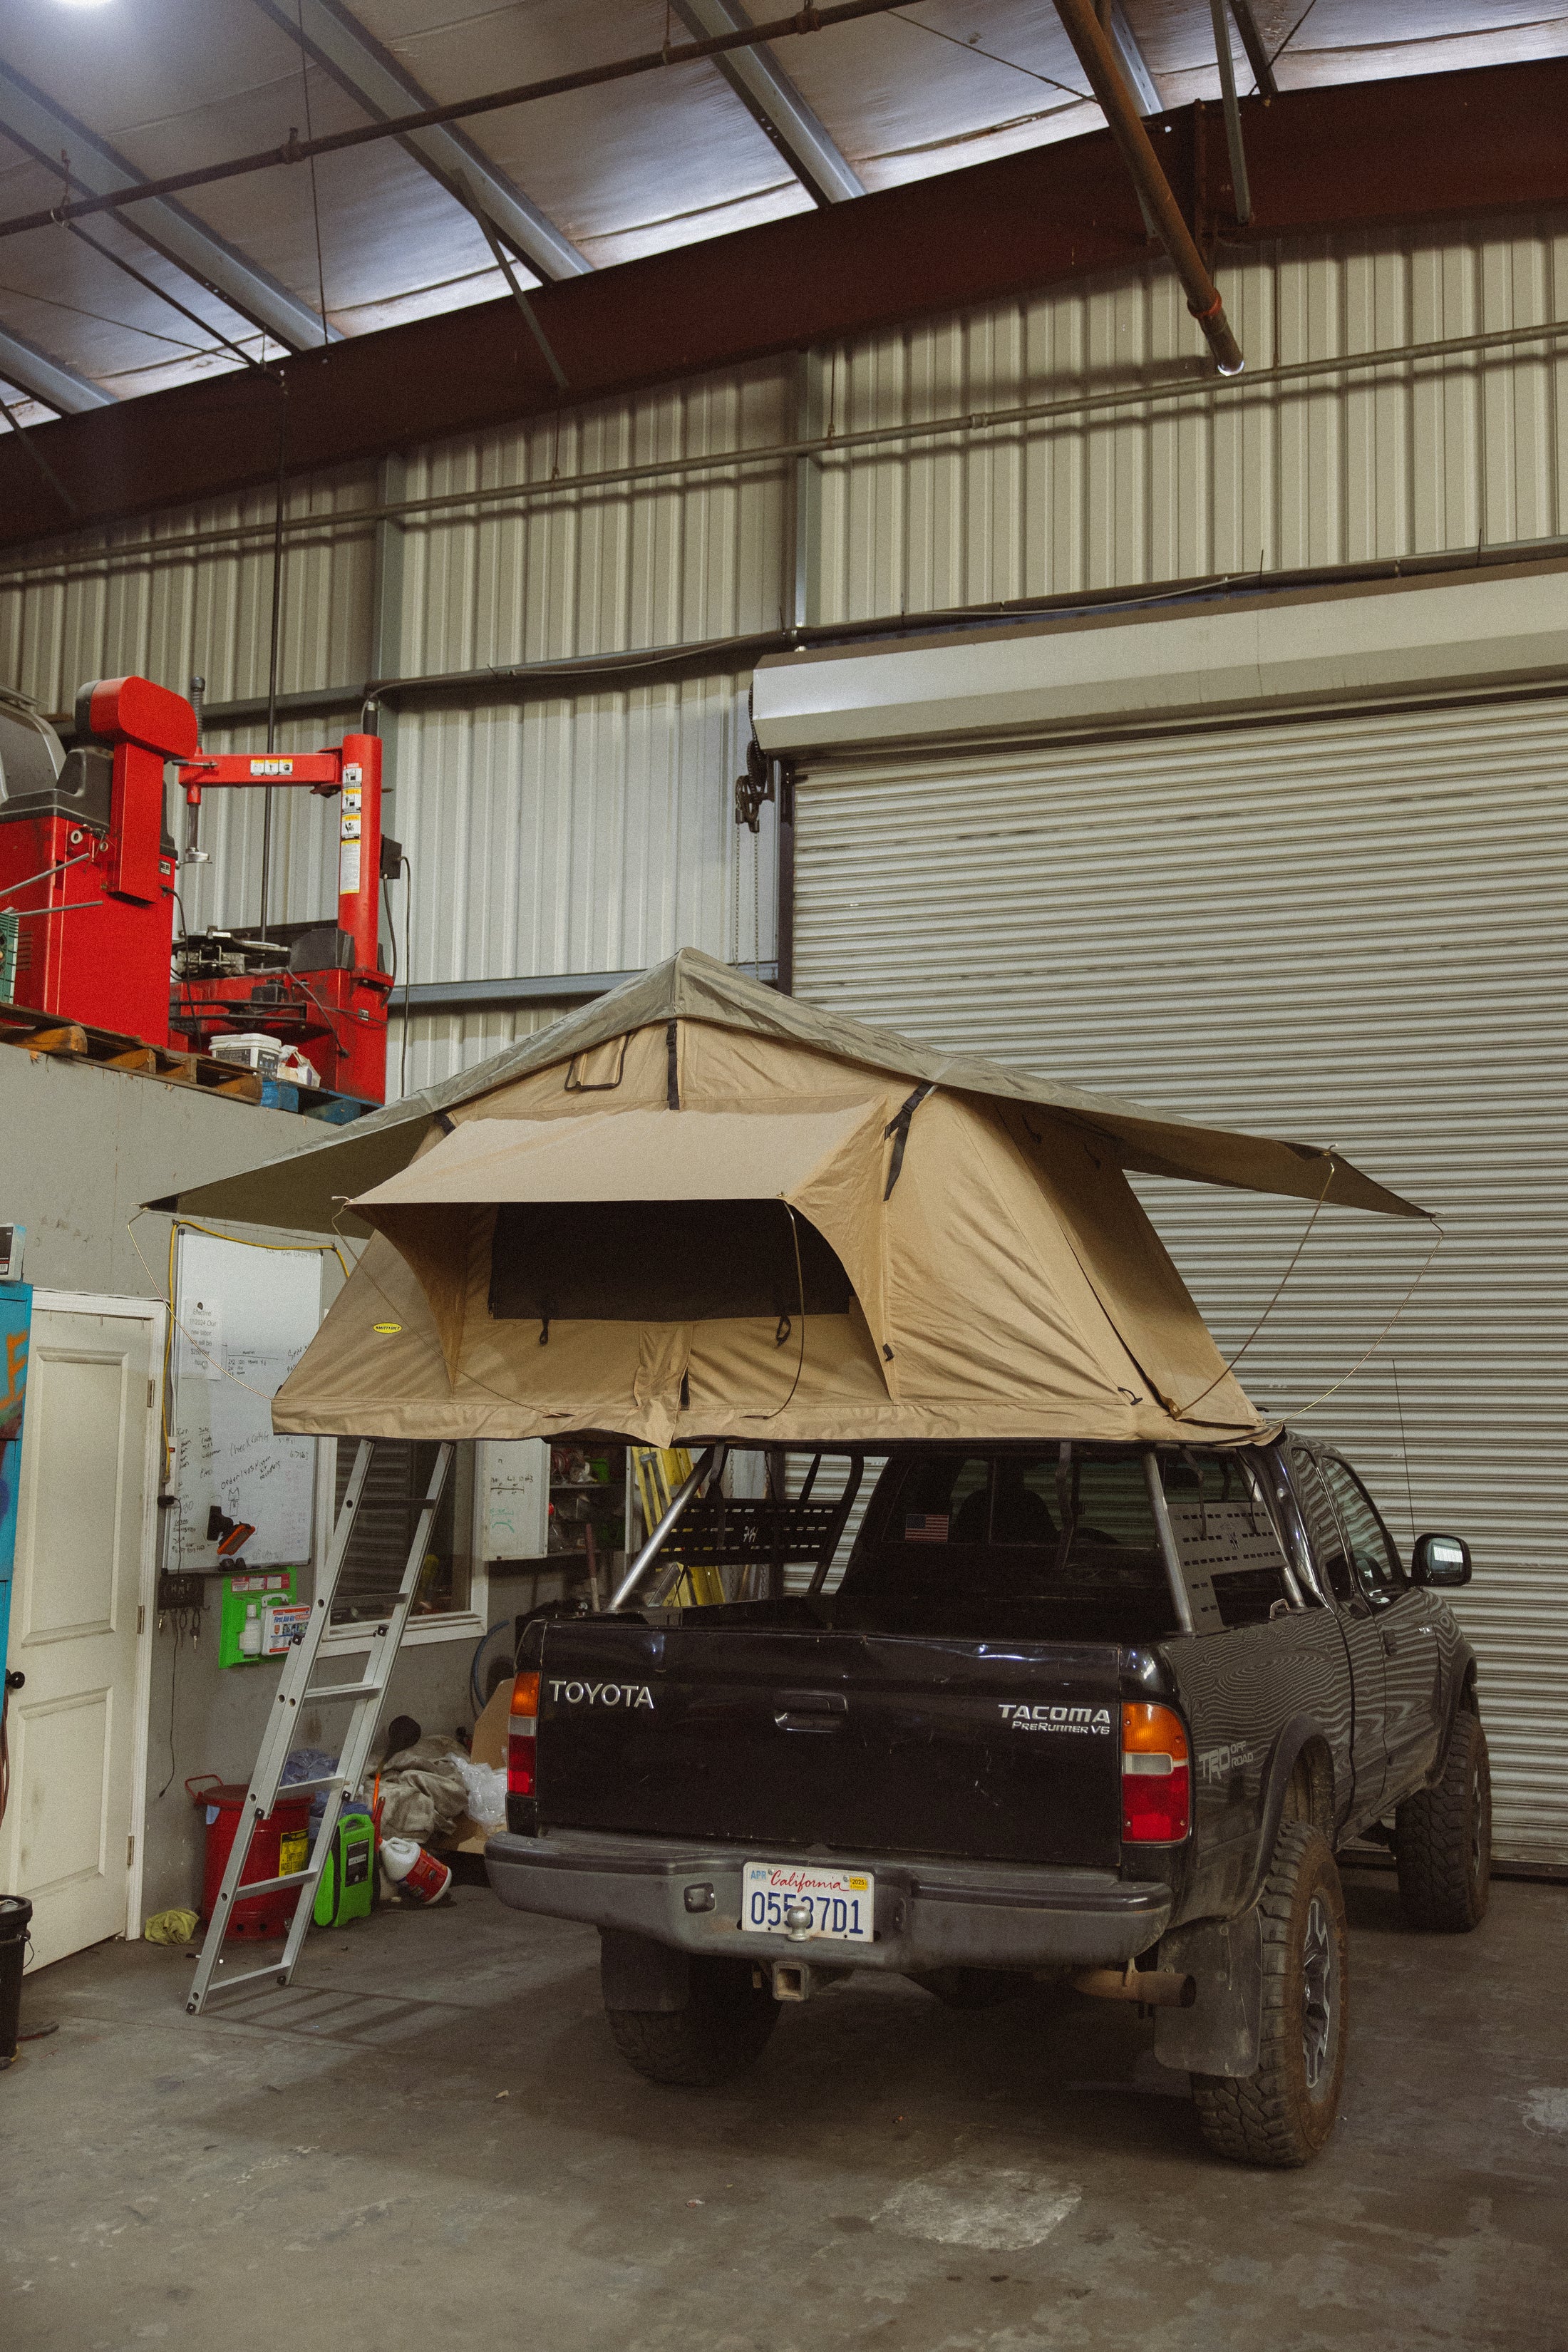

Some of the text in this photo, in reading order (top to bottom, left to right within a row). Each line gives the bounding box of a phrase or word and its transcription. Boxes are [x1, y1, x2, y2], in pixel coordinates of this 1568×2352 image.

[548, 1680, 655, 1710] TOYOTA
[998, 1703, 1111, 1724] TACOMA
[1090, 1725, 1111, 1735] V6
[1197, 1740, 1247, 1784] TRD OFF
[1231, 1752, 1254, 1768] ROAD
[751, 1869, 767, 1880] APR
[770, 1869, 850, 1893] California
